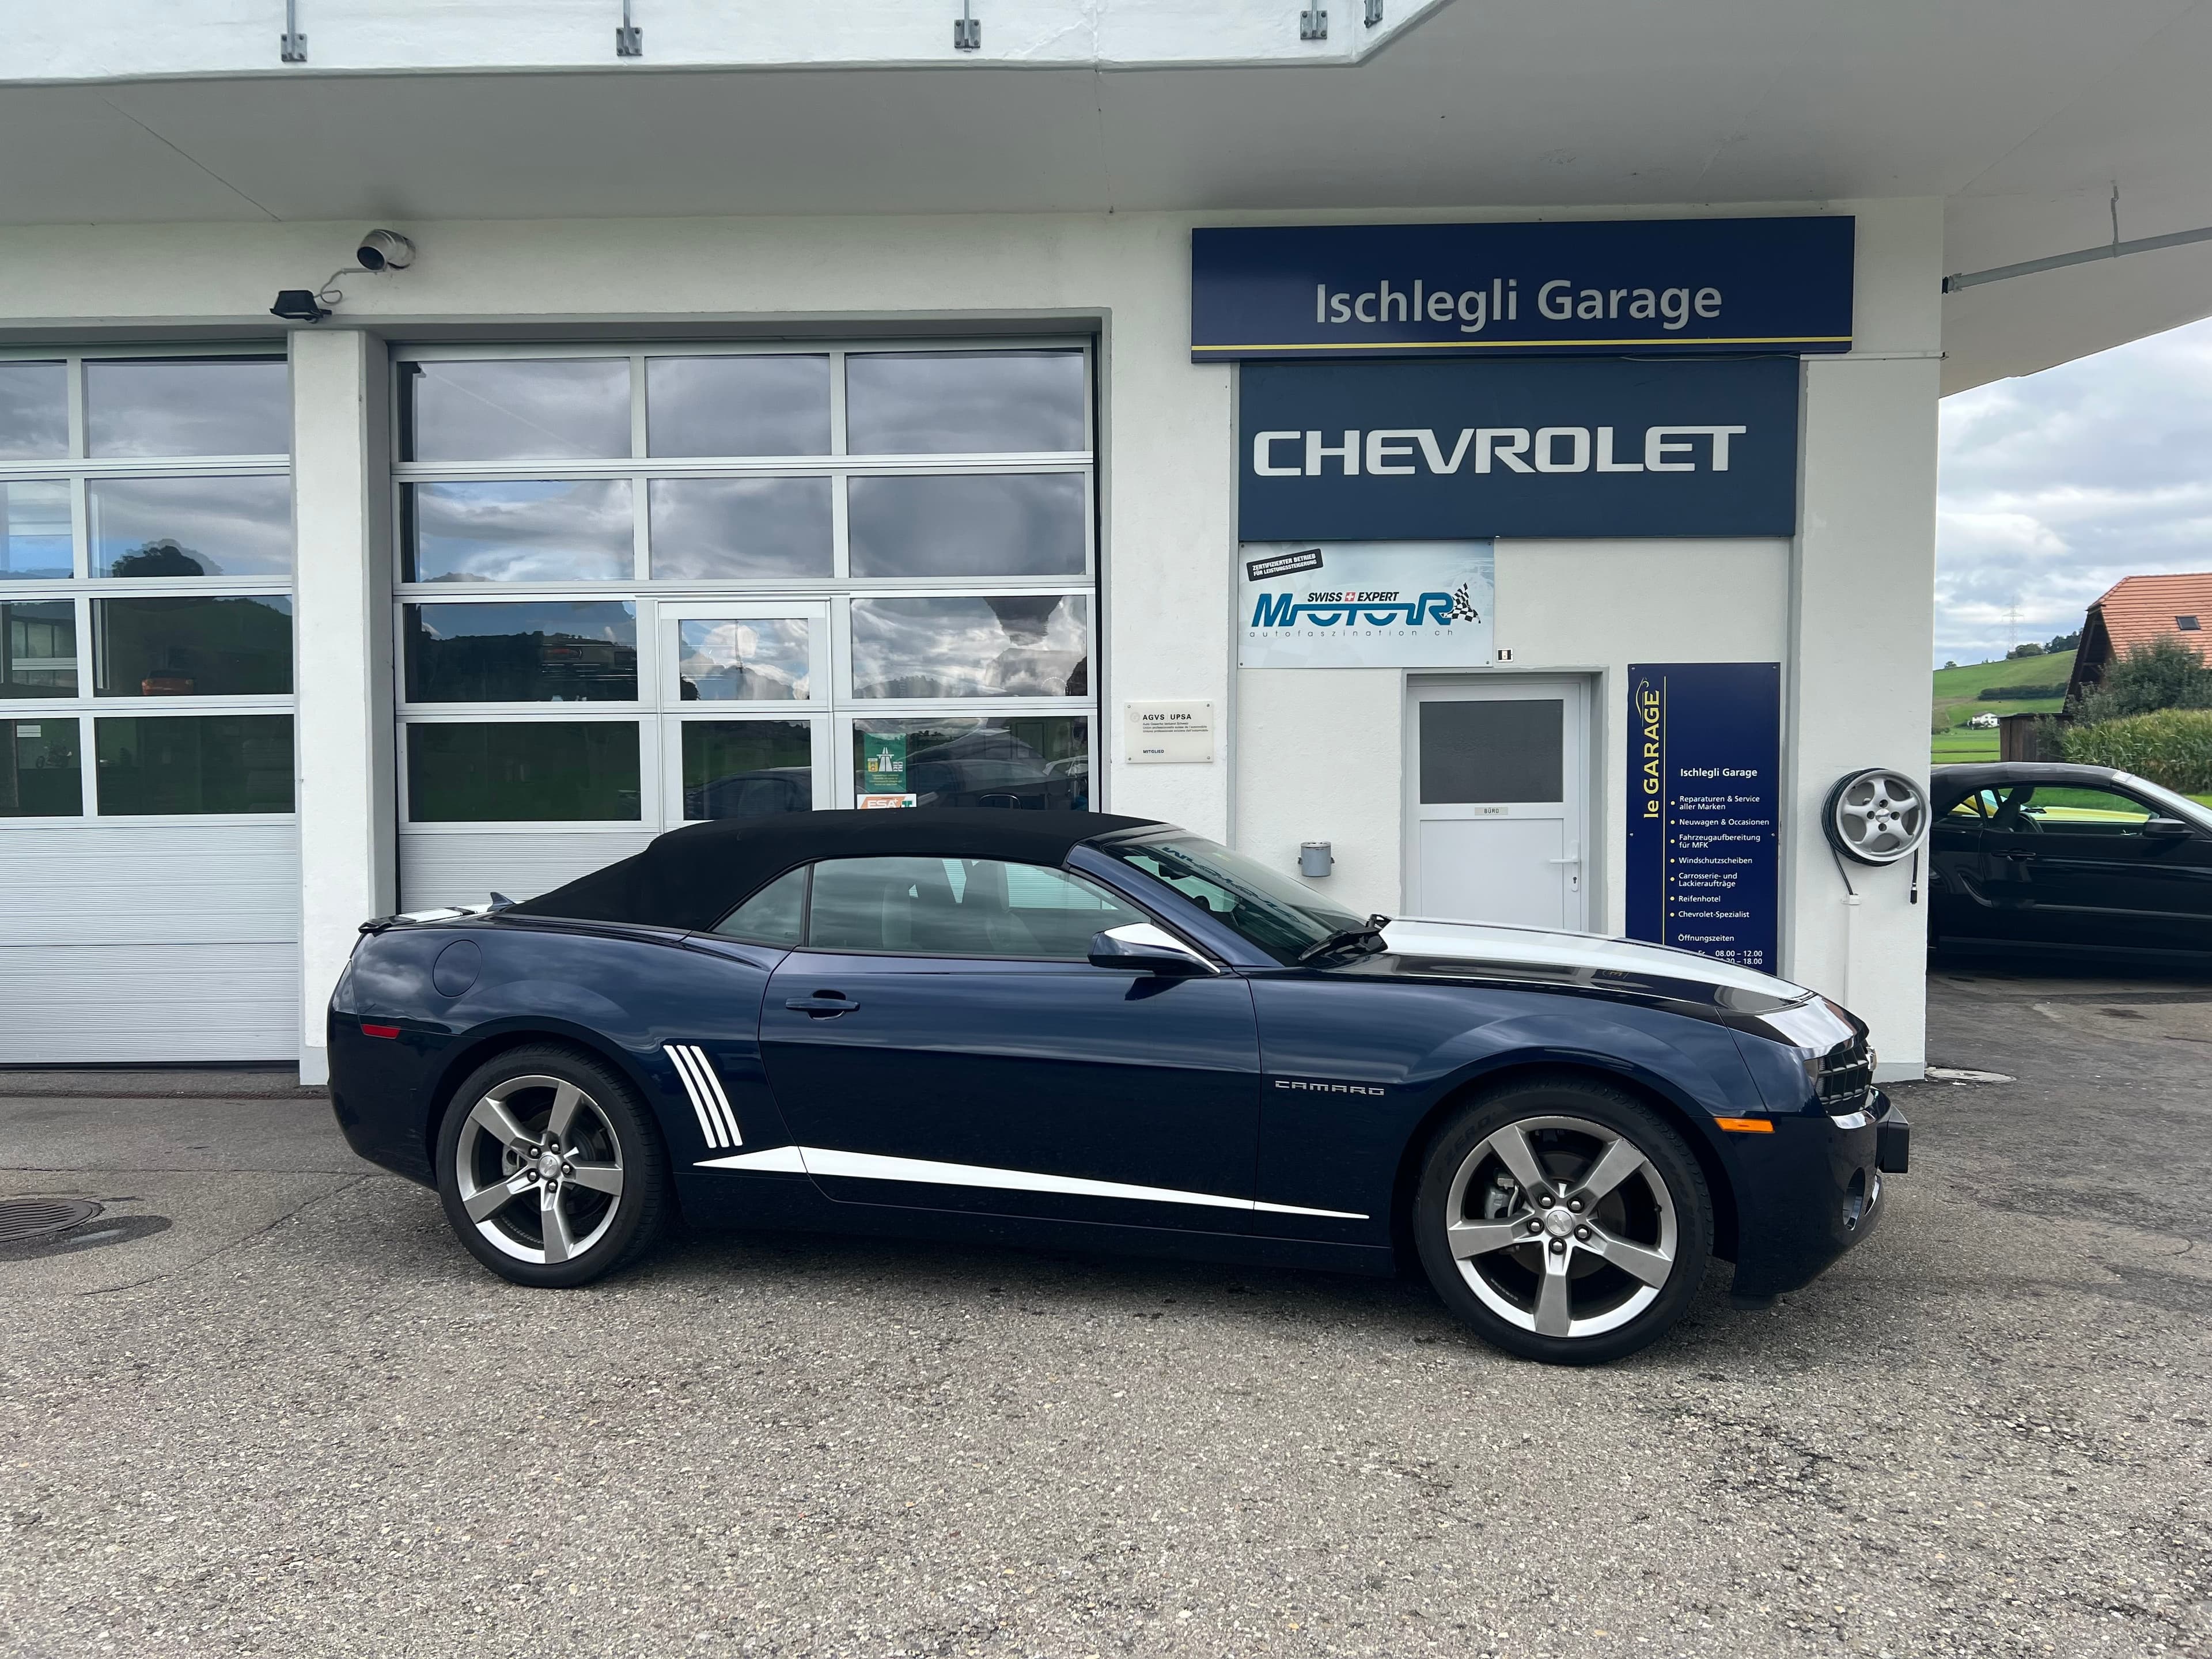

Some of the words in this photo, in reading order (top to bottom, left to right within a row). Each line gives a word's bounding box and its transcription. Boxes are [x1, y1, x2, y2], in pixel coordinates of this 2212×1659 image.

[1317, 278, 1517, 333] Ischlegli
[1537, 279, 1722, 330] Garage
[1253, 425, 1747, 476] CHEVROLET
[1252, 558, 1293, 571] ZERTIFIZIERTER
[1293, 553, 1316, 563] BETRIEB
[1264, 559, 1317, 575] LEISTUNGSSTEIGERUNG
[1307, 592, 1343, 603] SWISS
[1357, 591, 1400, 602] EXPERT
[1643, 690, 1660, 794] GARAGE
[1680, 767, 1720, 779] Ischlegli
[1722, 768, 1758, 779] Garage
[1680, 796, 1725, 804] Reparaturen
[1643, 800, 1659, 818] le
[1679, 819, 1719, 827] Neuwagen
[1679, 834, 1761, 842] Fahrzeugaufbereitung
[1679, 880, 1736, 889] Lackieraufträge
[1679, 895, 1721, 903] Reifenhotel
[1678, 910, 1750, 919] Chevrolet-Spezialist
[1678, 933, 1734, 943] Öffnungszeiten
[1275, 1080, 1385, 1096] CAMARO
